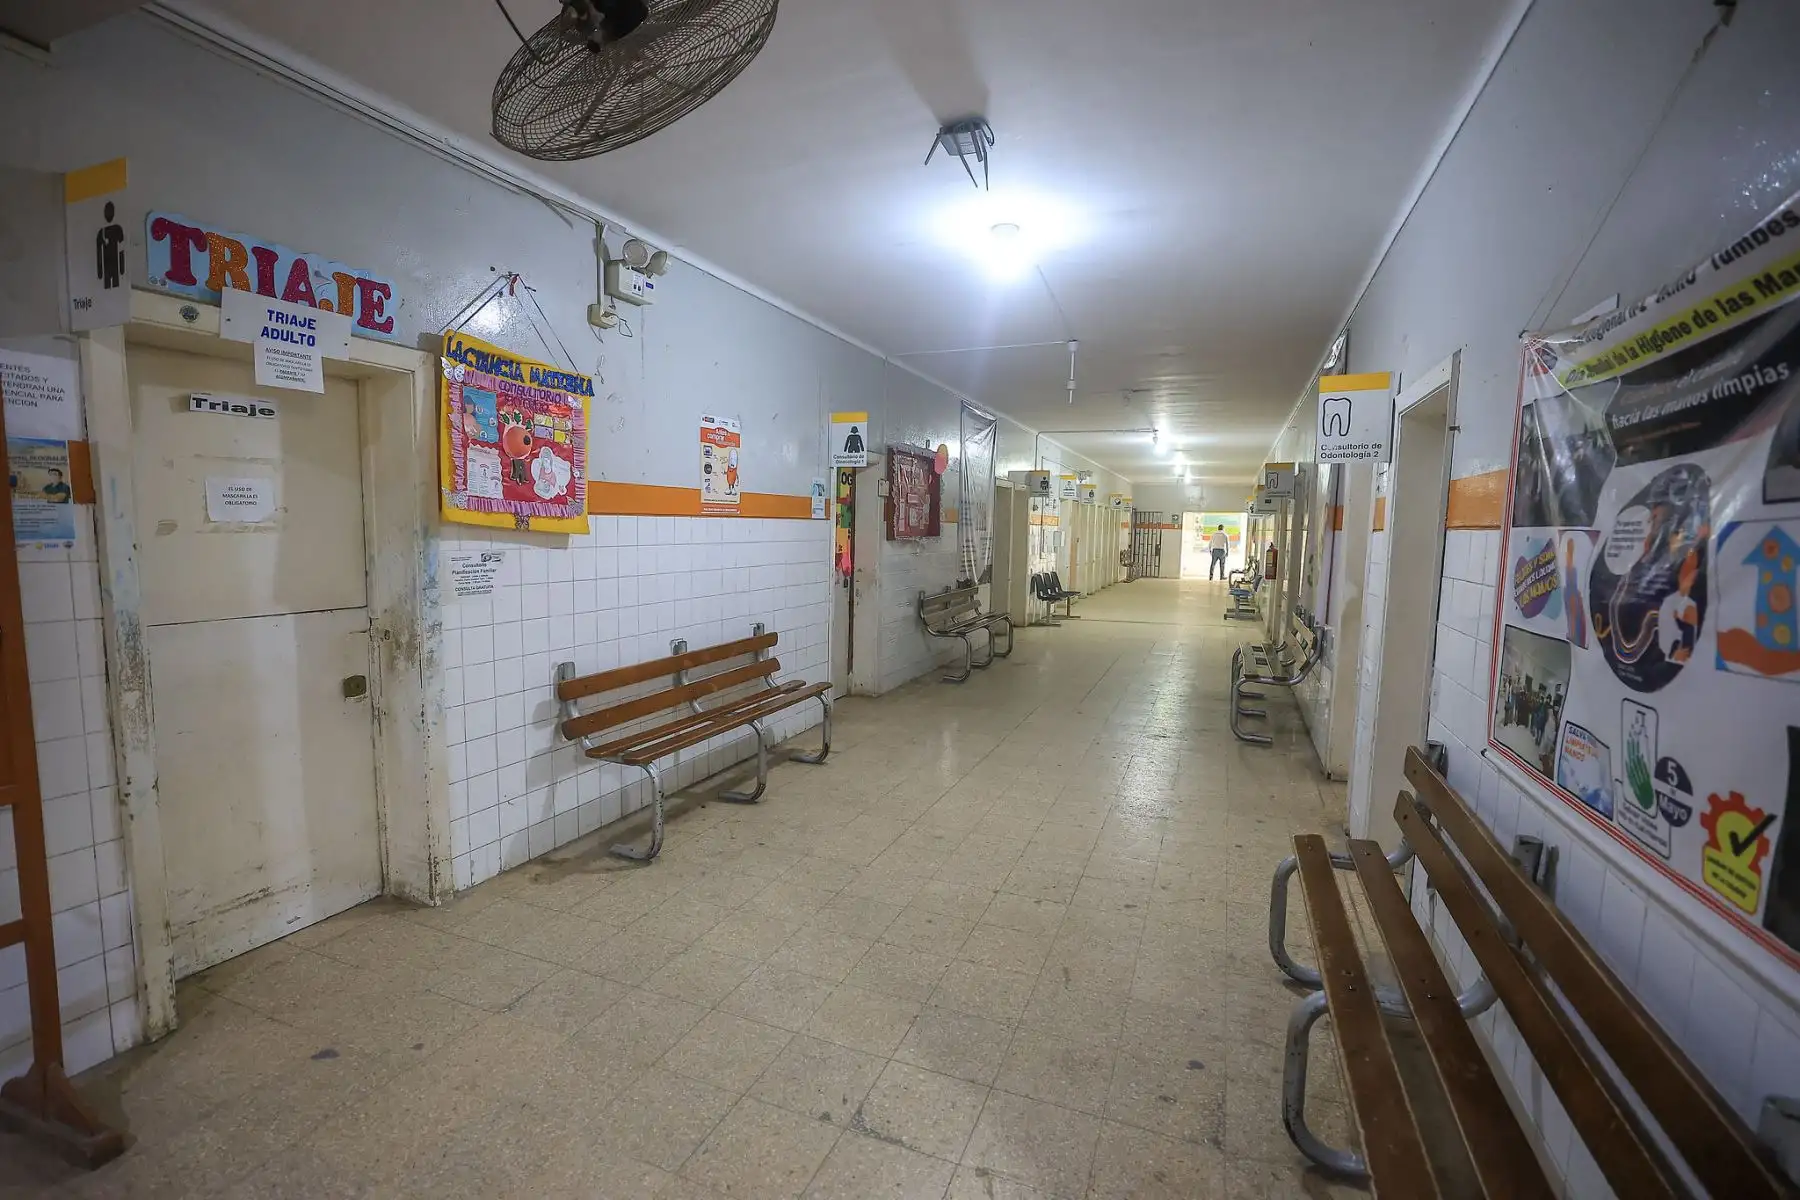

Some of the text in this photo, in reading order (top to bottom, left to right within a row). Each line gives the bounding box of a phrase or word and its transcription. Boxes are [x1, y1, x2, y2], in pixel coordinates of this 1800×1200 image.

[151, 217, 394, 334] TRIAJE
[267, 309, 317, 330] TRIAJE
[1636, 322, 1692, 354] Higiene
[1692, 309, 1719, 330] de
[1713, 291, 1756, 317] las
[260, 326, 316, 347] ADULTO
[446, 335, 525, 383] LACTANCIA
[192, 397, 275, 416] Triaje
[1612, 408, 1641, 429] hacia
[1641, 405, 1661, 422] las
[1661, 388, 1709, 416] manos
[1711, 361, 1790, 400] limpias
[1321, 443, 1369, 451] Cnsultorio
[1667, 760, 1678, 787] 5
[1659, 792, 1688, 821] Mayo
